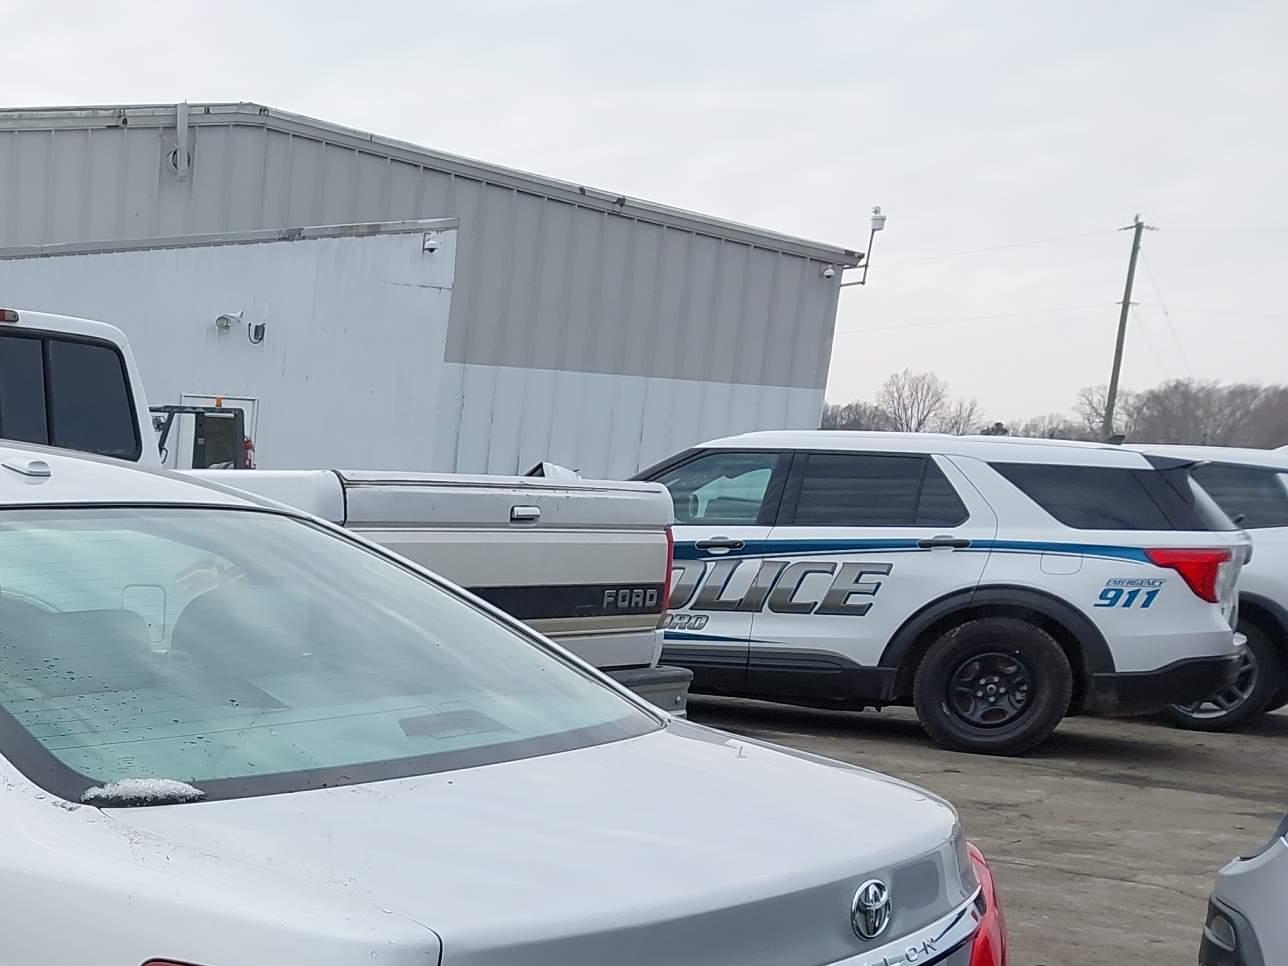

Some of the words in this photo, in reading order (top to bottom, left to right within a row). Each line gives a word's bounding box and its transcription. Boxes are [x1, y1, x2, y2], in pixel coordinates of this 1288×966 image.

[667, 558, 894, 616] OLICE
[1093, 587, 1161, 609] 911
[602, 588, 659, 609] FORD
